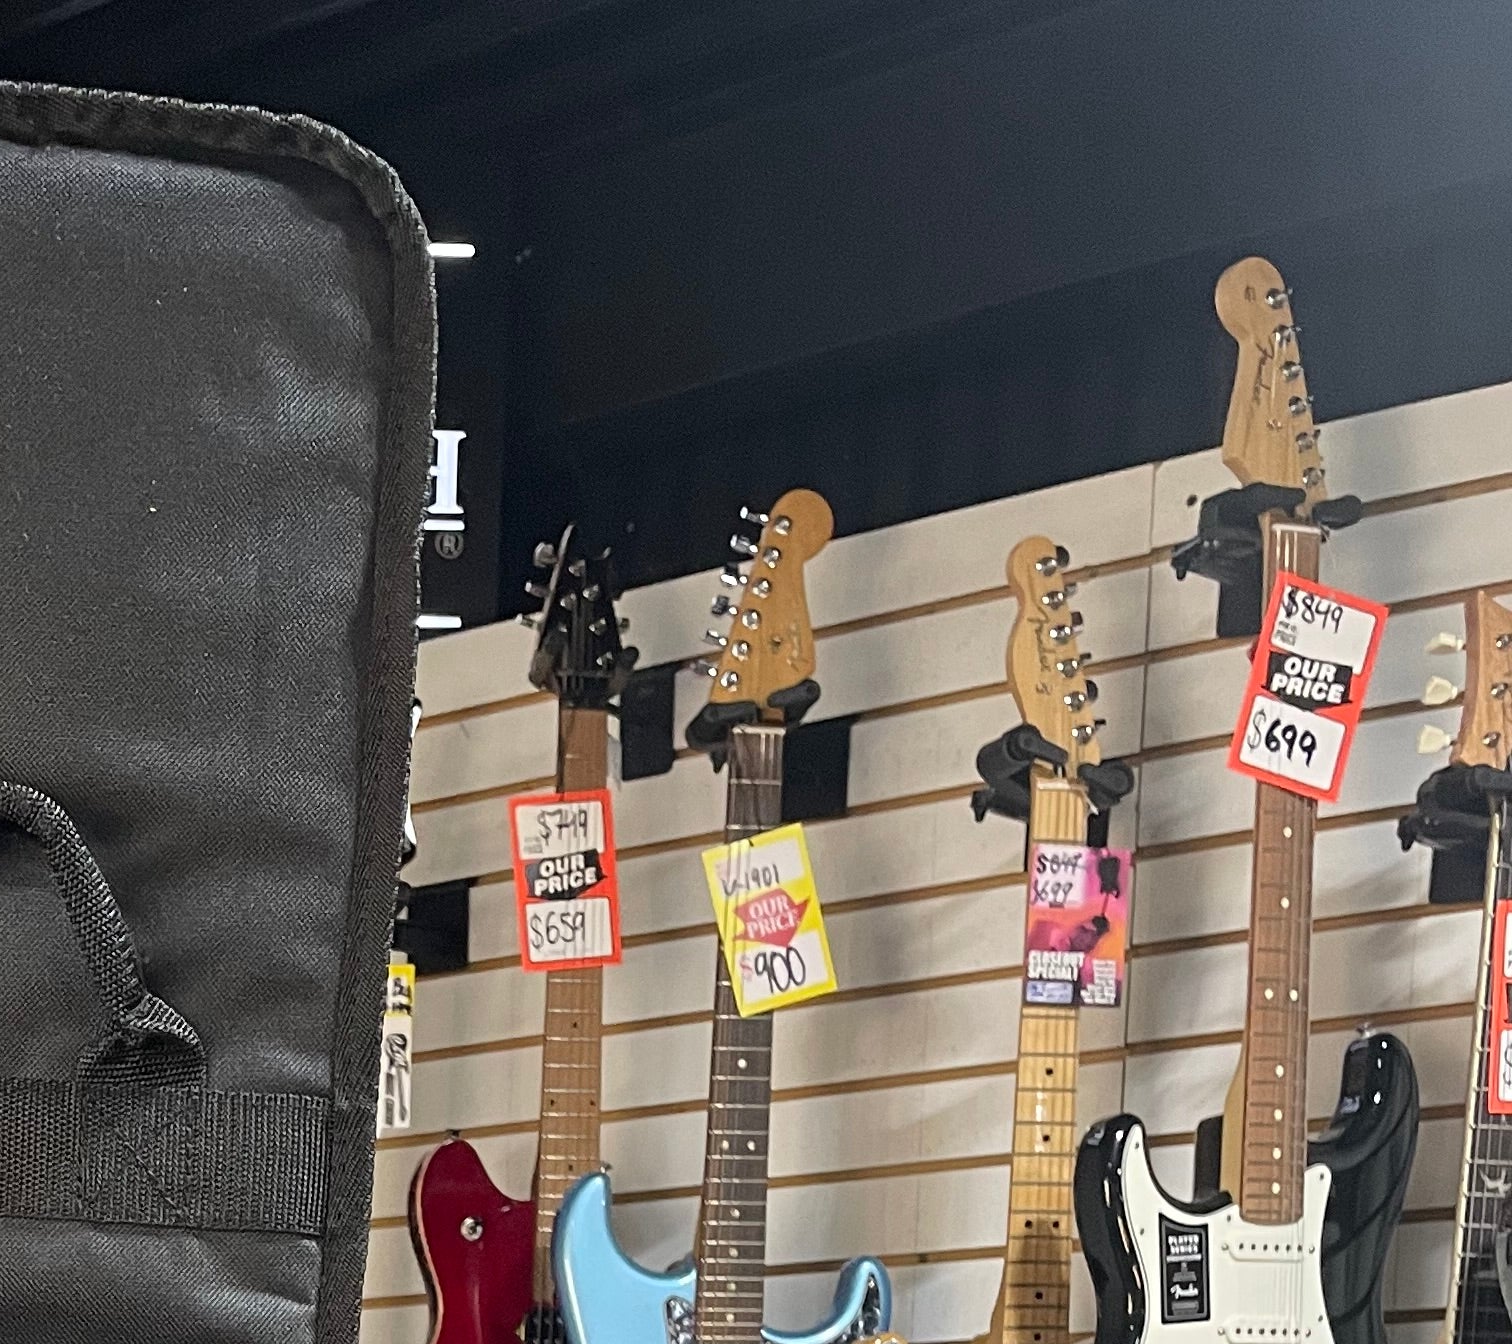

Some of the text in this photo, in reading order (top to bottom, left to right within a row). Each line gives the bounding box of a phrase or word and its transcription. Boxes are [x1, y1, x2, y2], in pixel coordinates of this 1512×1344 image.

[1283, 586, 1344, 633] $849
[1283, 656, 1337, 683] OUR
[1270, 673, 1346, 704] PRICE
[1246, 708, 1317, 768] $699
[539, 853, 585, 878] OUR
[533, 867, 598, 897] PRICE
[748, 893, 790, 919] OUR
[529, 910, 586, 951] $659
[746, 909, 801, 939] PRICE
[1168, 1233, 1200, 1247] PLAYER
[1169, 1244, 1199, 1256] SERIES
